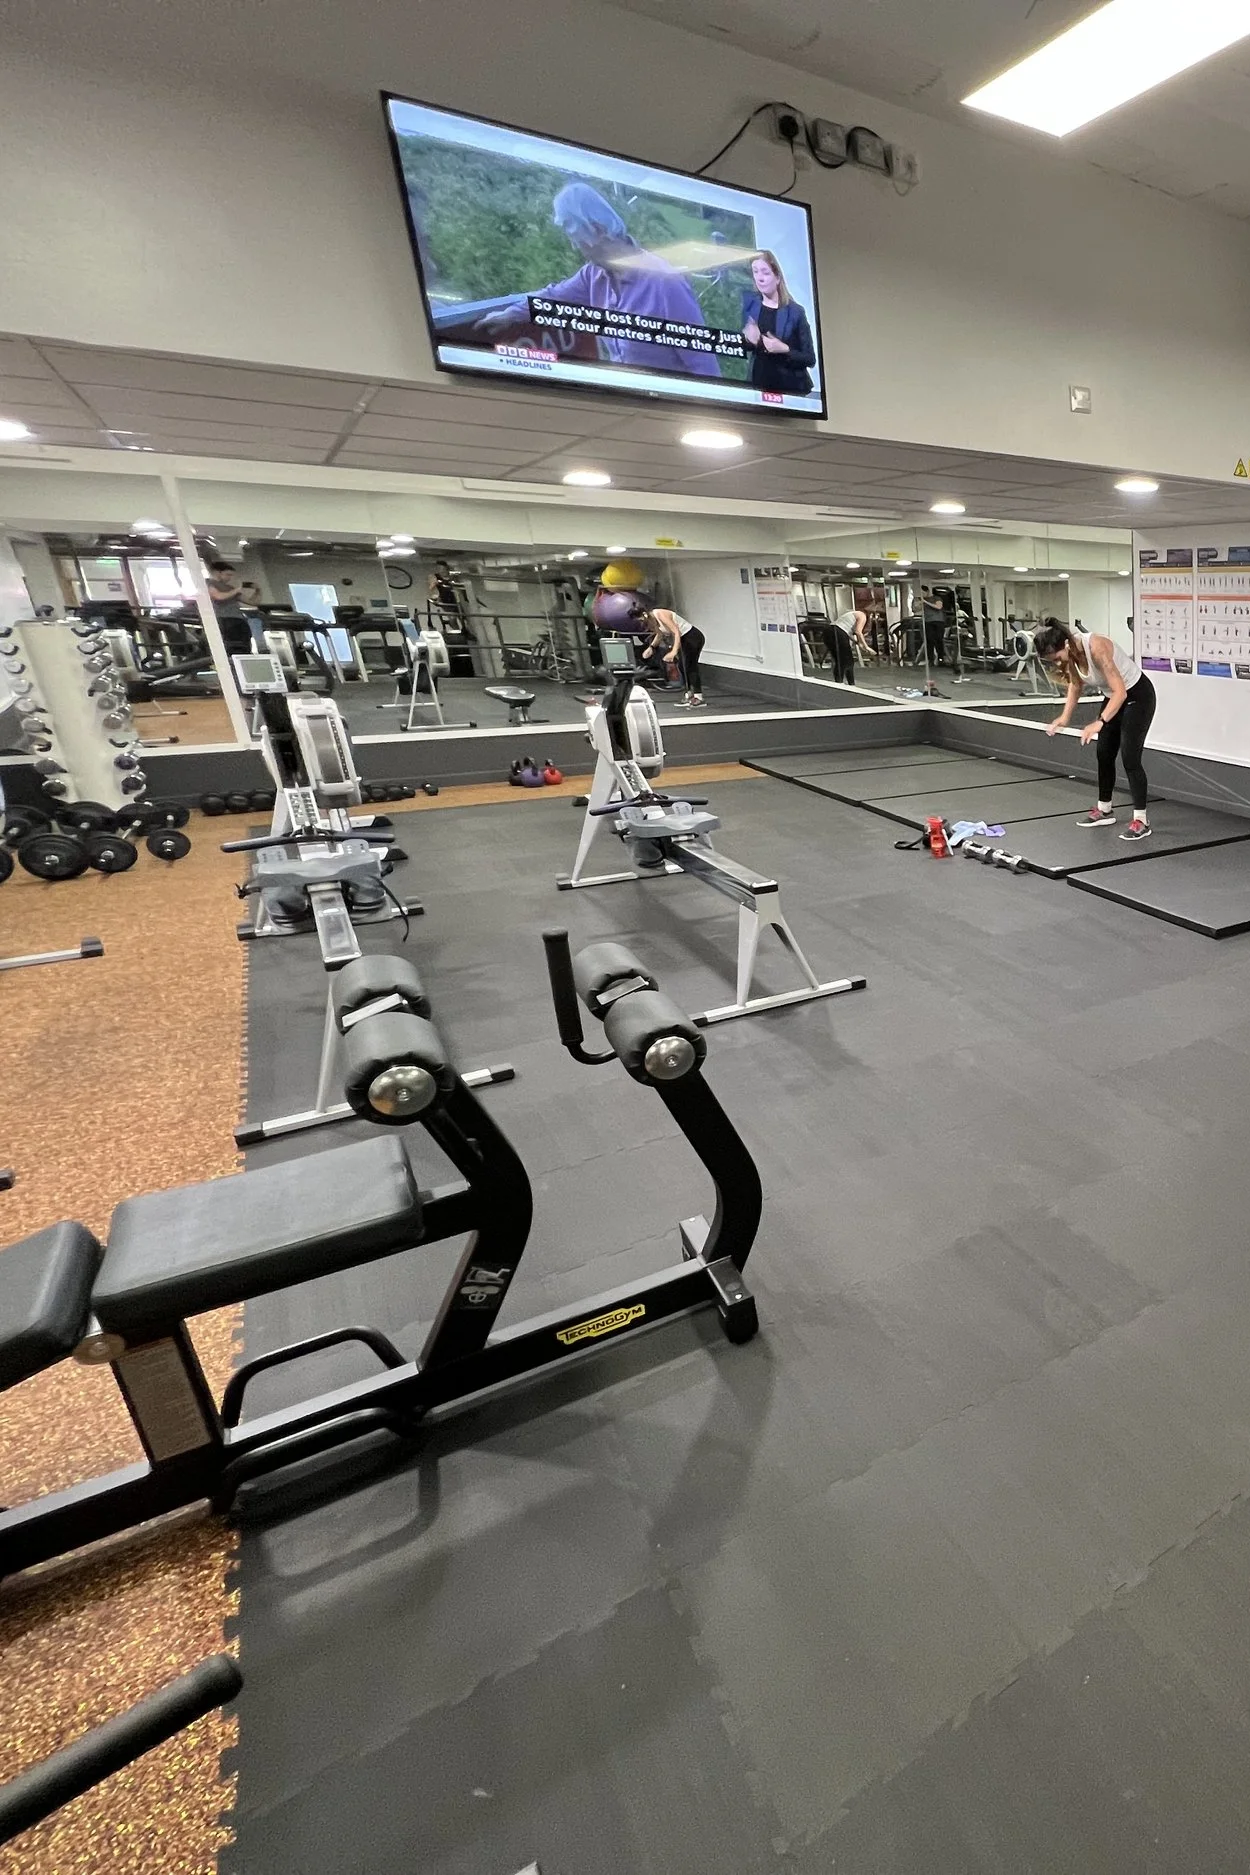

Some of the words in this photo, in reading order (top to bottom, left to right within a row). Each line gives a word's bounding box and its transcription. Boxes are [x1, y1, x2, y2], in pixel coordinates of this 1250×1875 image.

[532, 298, 552, 311] So
[556, 304, 602, 320] you've
[605, 310, 632, 325] lost
[635, 316, 662, 329] four
[666, 323, 716, 341] metres,
[719, 330, 743, 344] just
[535, 315, 567, 328] over
[570, 318, 600, 333] four
[604, 326, 652, 342] metres
[655, 333, 688, 348] since
[691, 339, 712, 352] the
[715, 344, 744, 357] start
[506, 358, 552, 371] HEADLINES
[528, 349, 557, 361] NEWS
